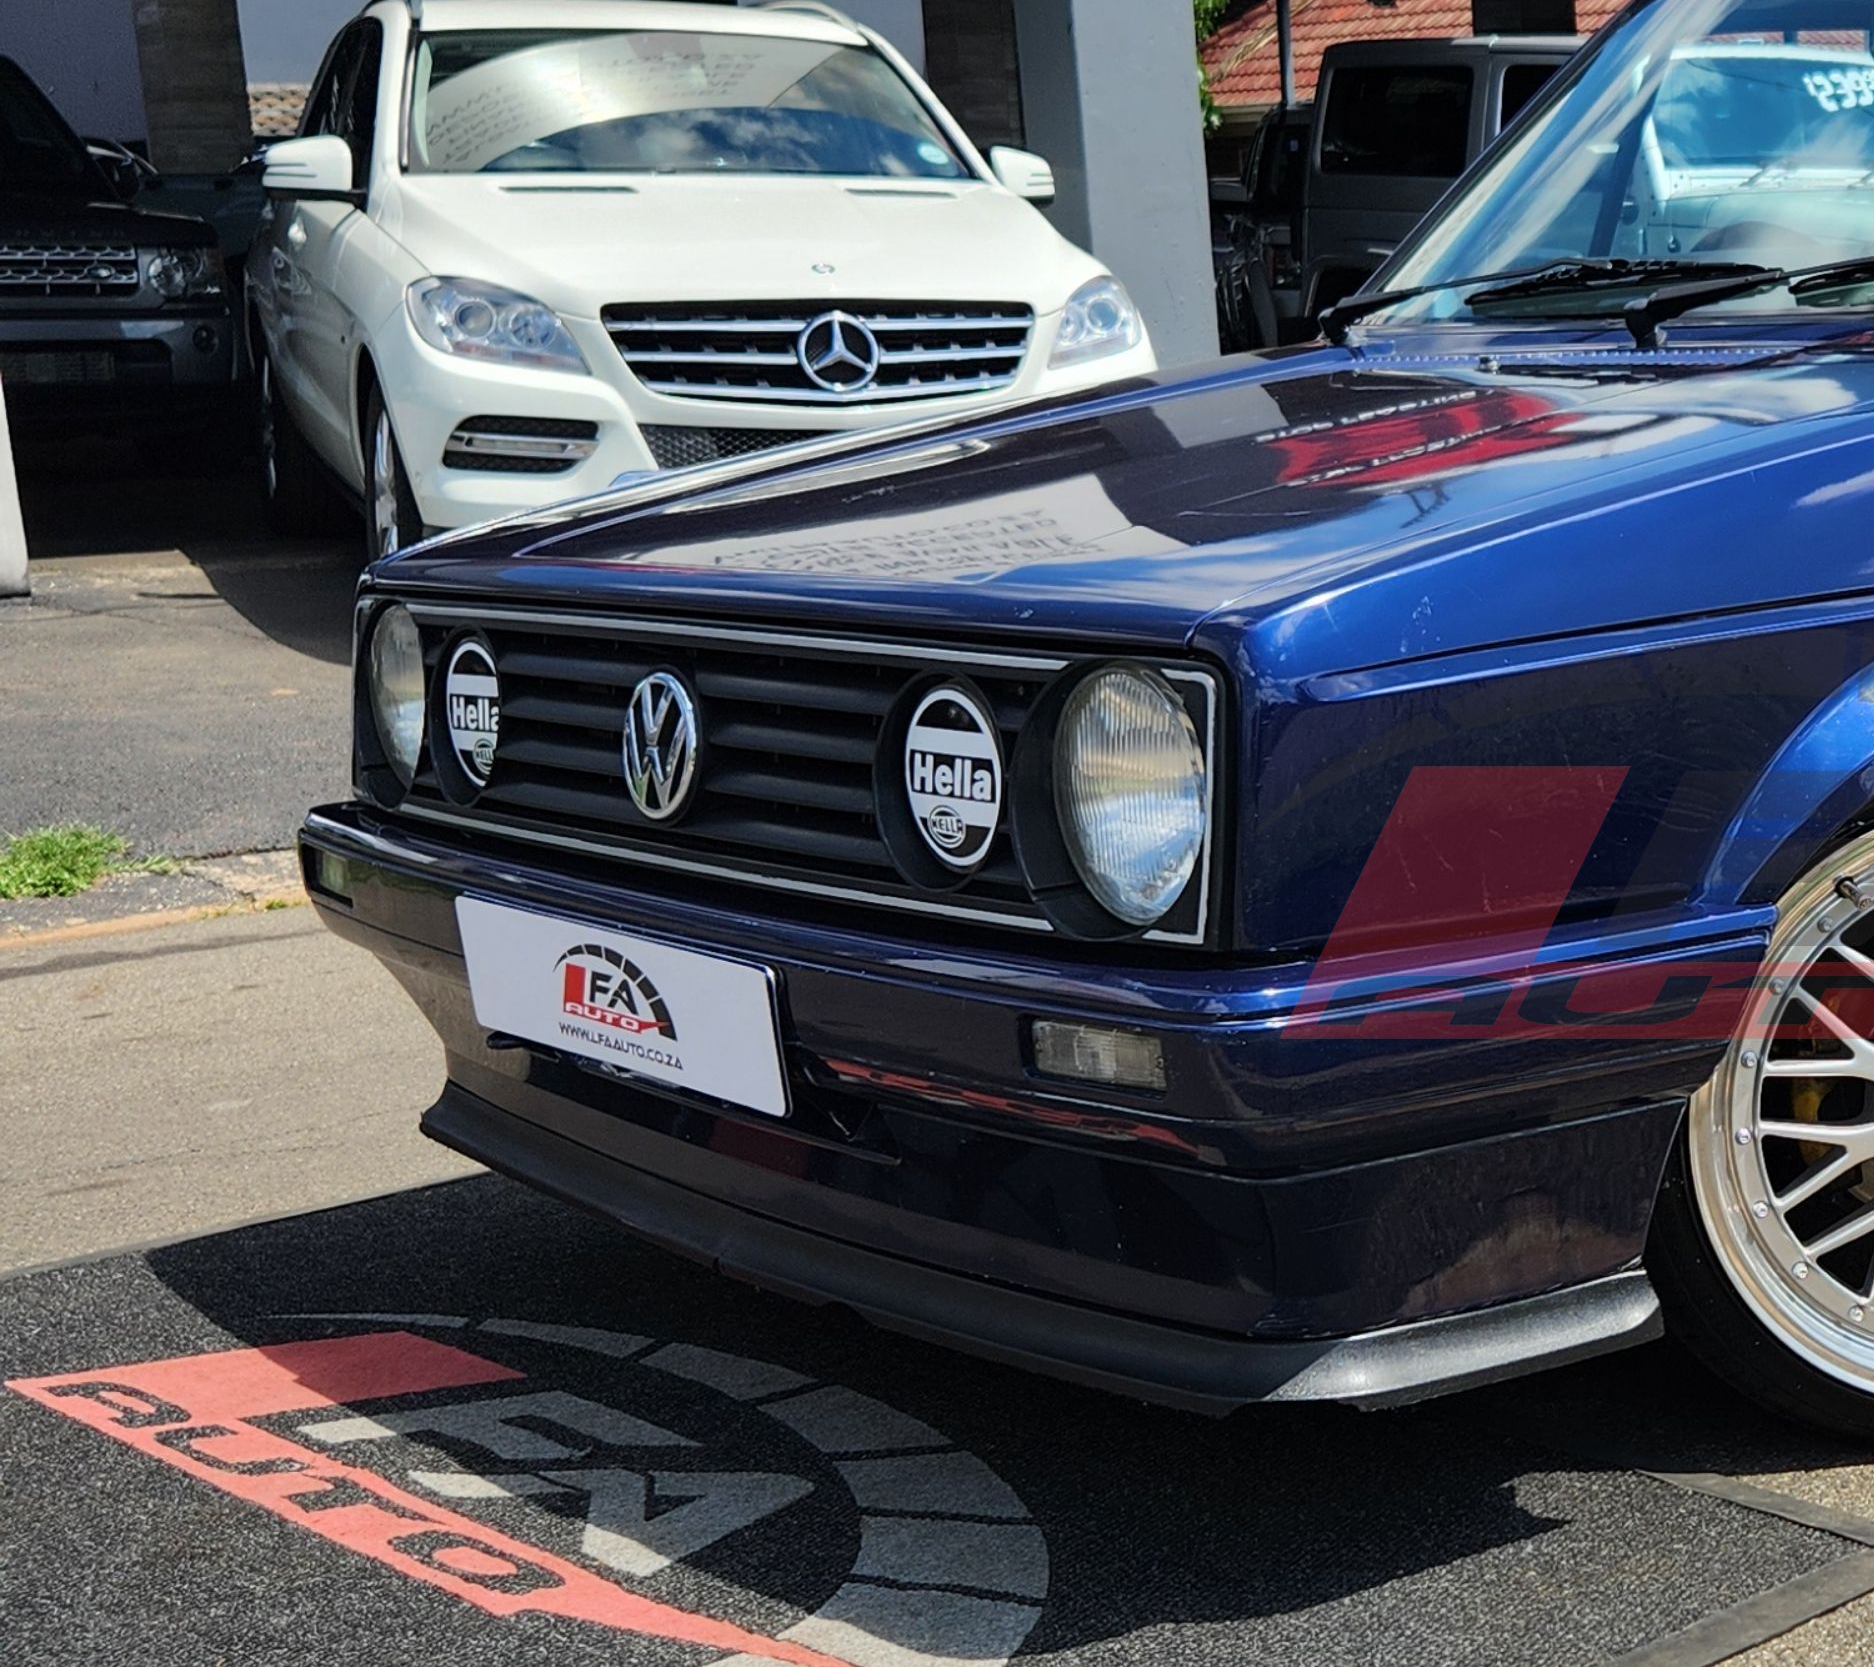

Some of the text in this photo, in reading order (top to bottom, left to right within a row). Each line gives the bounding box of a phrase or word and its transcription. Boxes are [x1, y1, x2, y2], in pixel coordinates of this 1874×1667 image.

[451, 695, 500, 732] Hella
[912, 751, 993, 802] Hella
[564, 1001, 641, 1032] AUTO
[50, 1378, 569, 1597] AUTO
